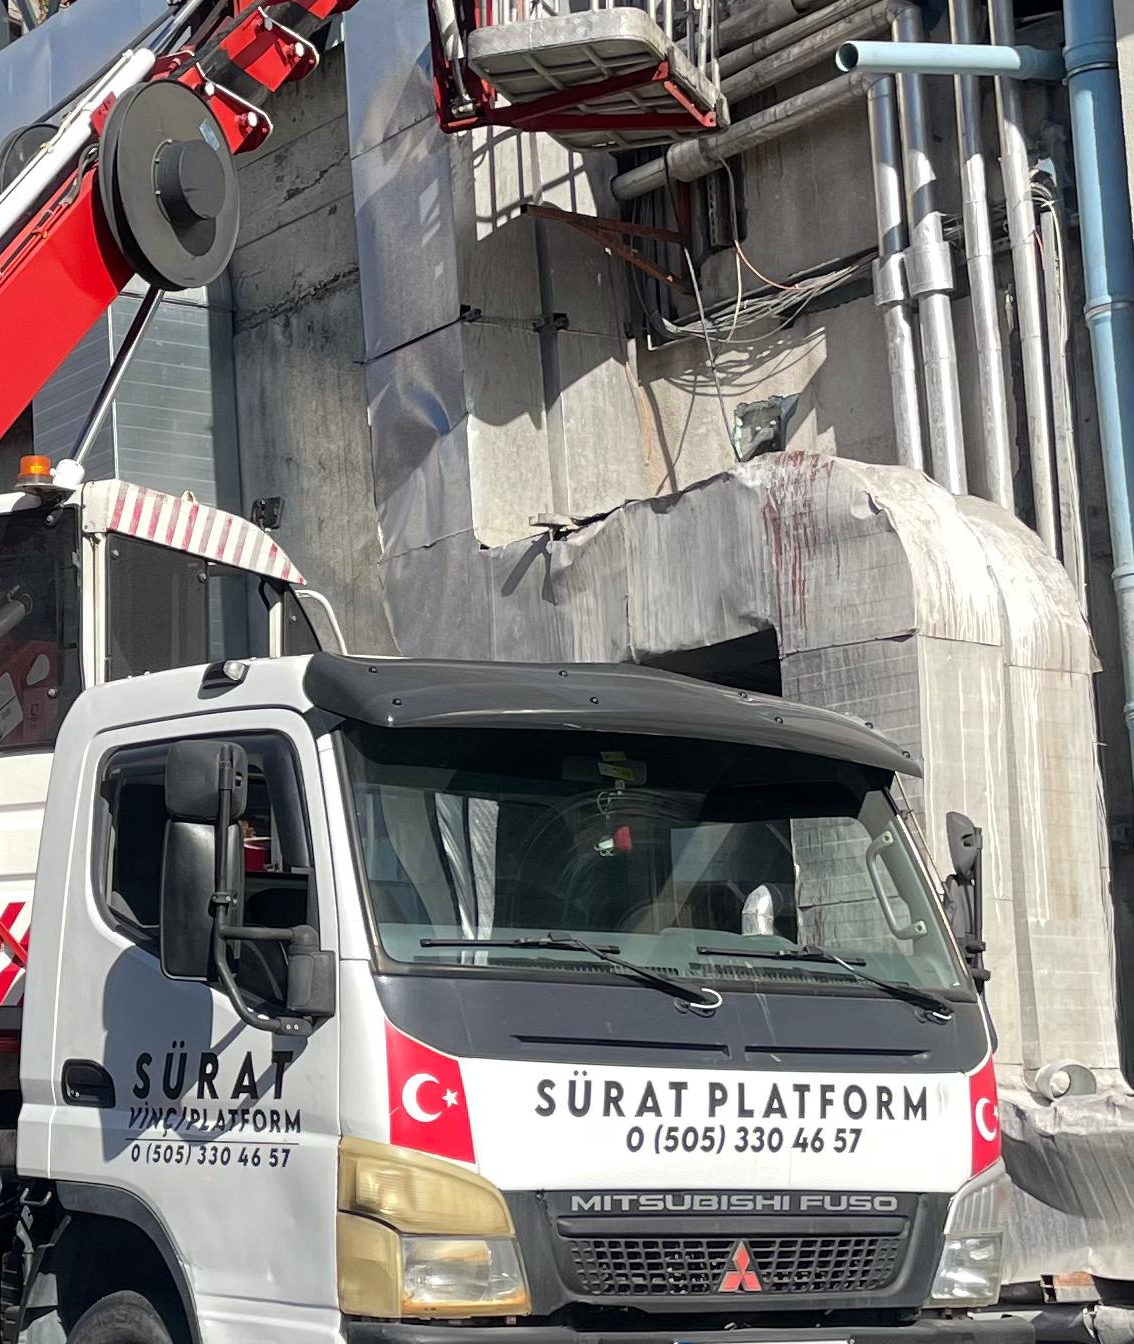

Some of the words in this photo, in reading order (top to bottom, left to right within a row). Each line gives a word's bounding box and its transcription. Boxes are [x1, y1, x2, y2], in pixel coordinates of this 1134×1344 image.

[132, 1041, 293, 1100] SÜRAT
[534, 1070, 688, 1118] SÜRAT
[708, 1082, 927, 1121] PLATFORM
[626, 1125, 645, 1153] 0
[654, 1124, 726, 1154] (505)
[734, 1126, 784, 1153] 330
[792, 1128, 825, 1154] 46
[833, 1128, 863, 1154] 57
[131, 1144, 141, 1162] 0
[146, 1143, 191, 1165] (505)
[197, 1146, 231, 1166] 330
[237, 1147, 261, 1167] 46
[268, 1148, 291, 1168] 57
[571, 1194, 791, 1212] MITSUBISHI
[799, 1195, 898, 1212] FUSO
